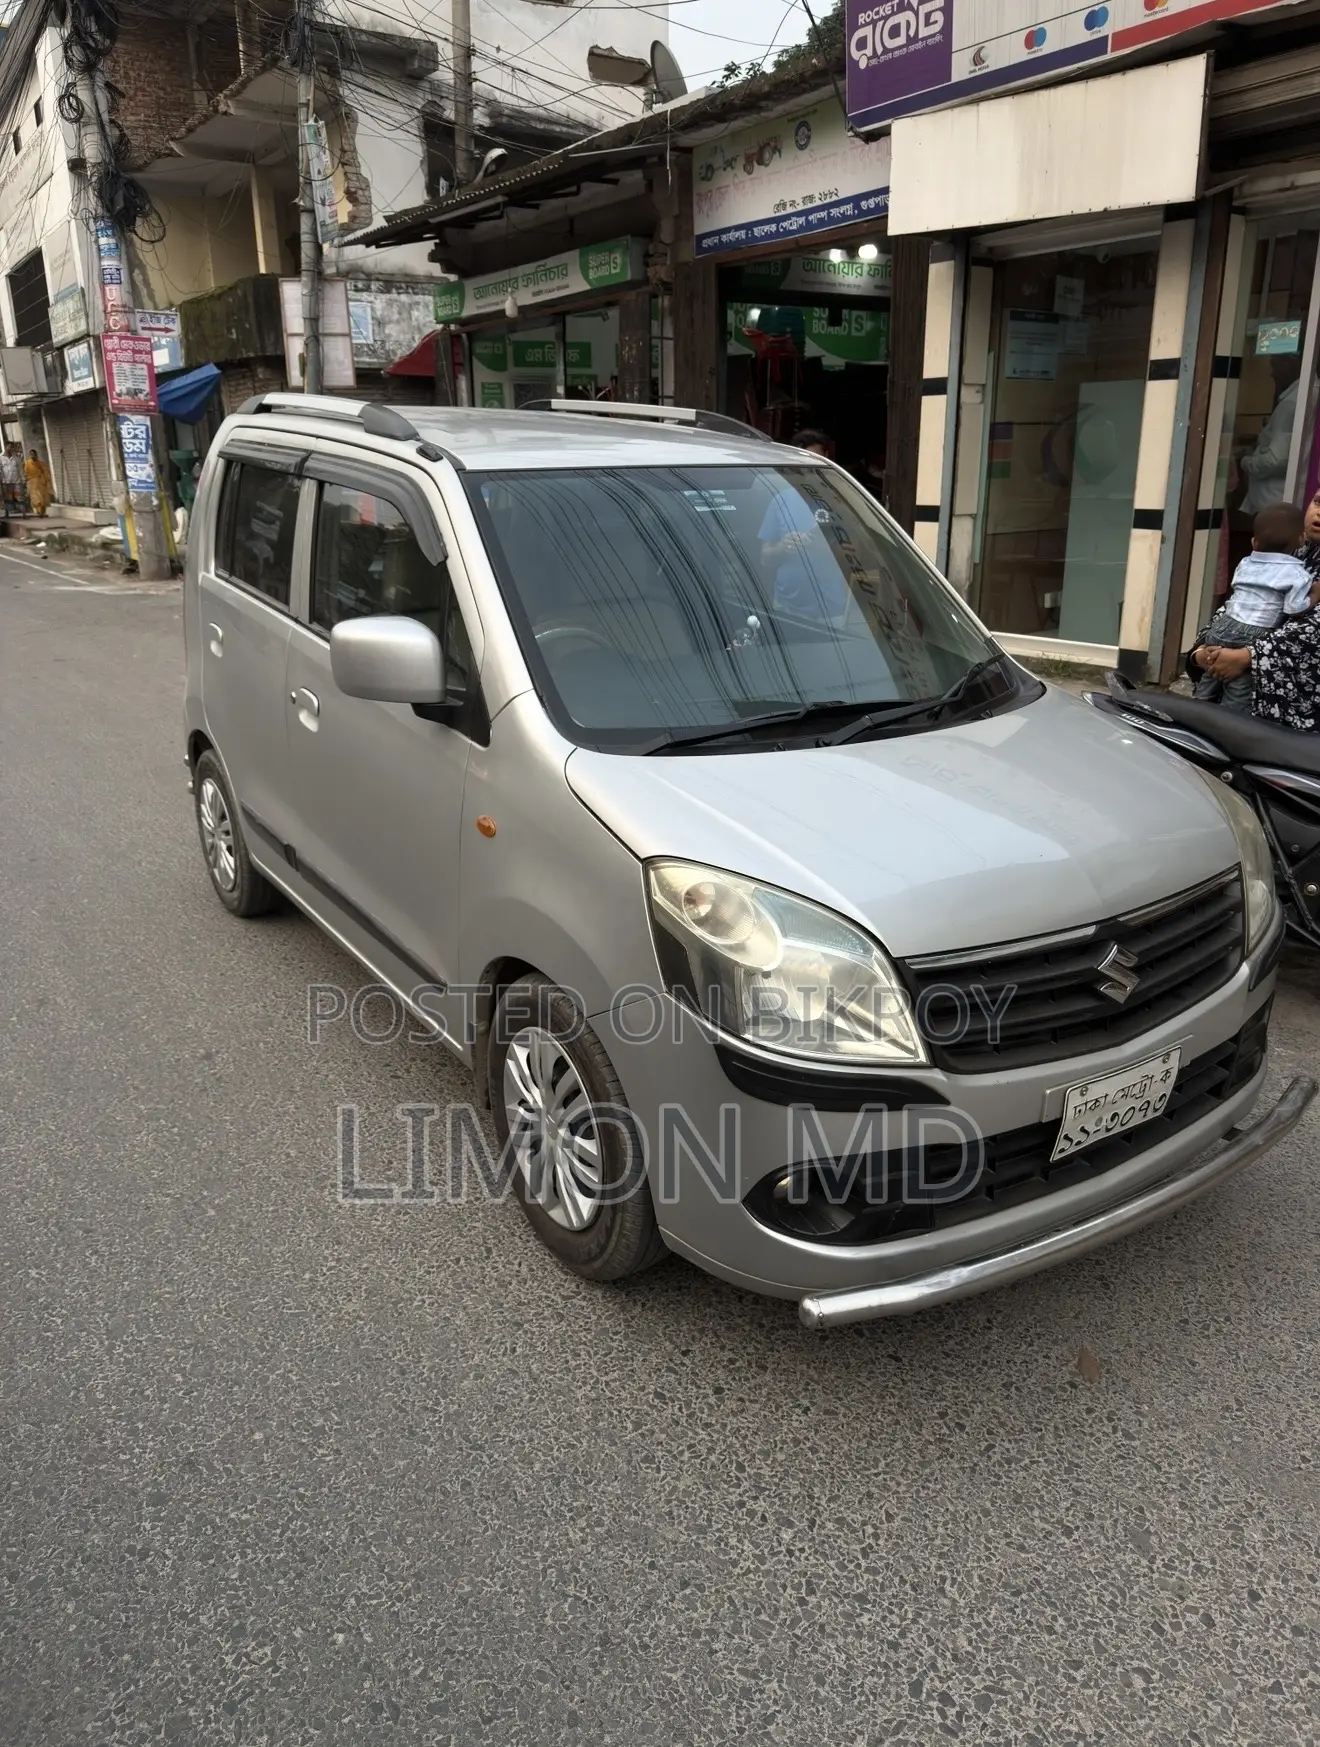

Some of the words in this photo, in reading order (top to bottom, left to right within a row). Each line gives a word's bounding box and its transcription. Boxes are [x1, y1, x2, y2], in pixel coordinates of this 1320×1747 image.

[858, 0, 899, 26] ROCKET
[817, 187, 840, 203] ২৮৮২
[802, 257, 865, 279] আনোয়ার
[473, 276, 520, 302] আনোয়ার
[521, 261, 569, 288] ফার্নিচার
[1072, 1093, 1110, 1121] ঢাকা
